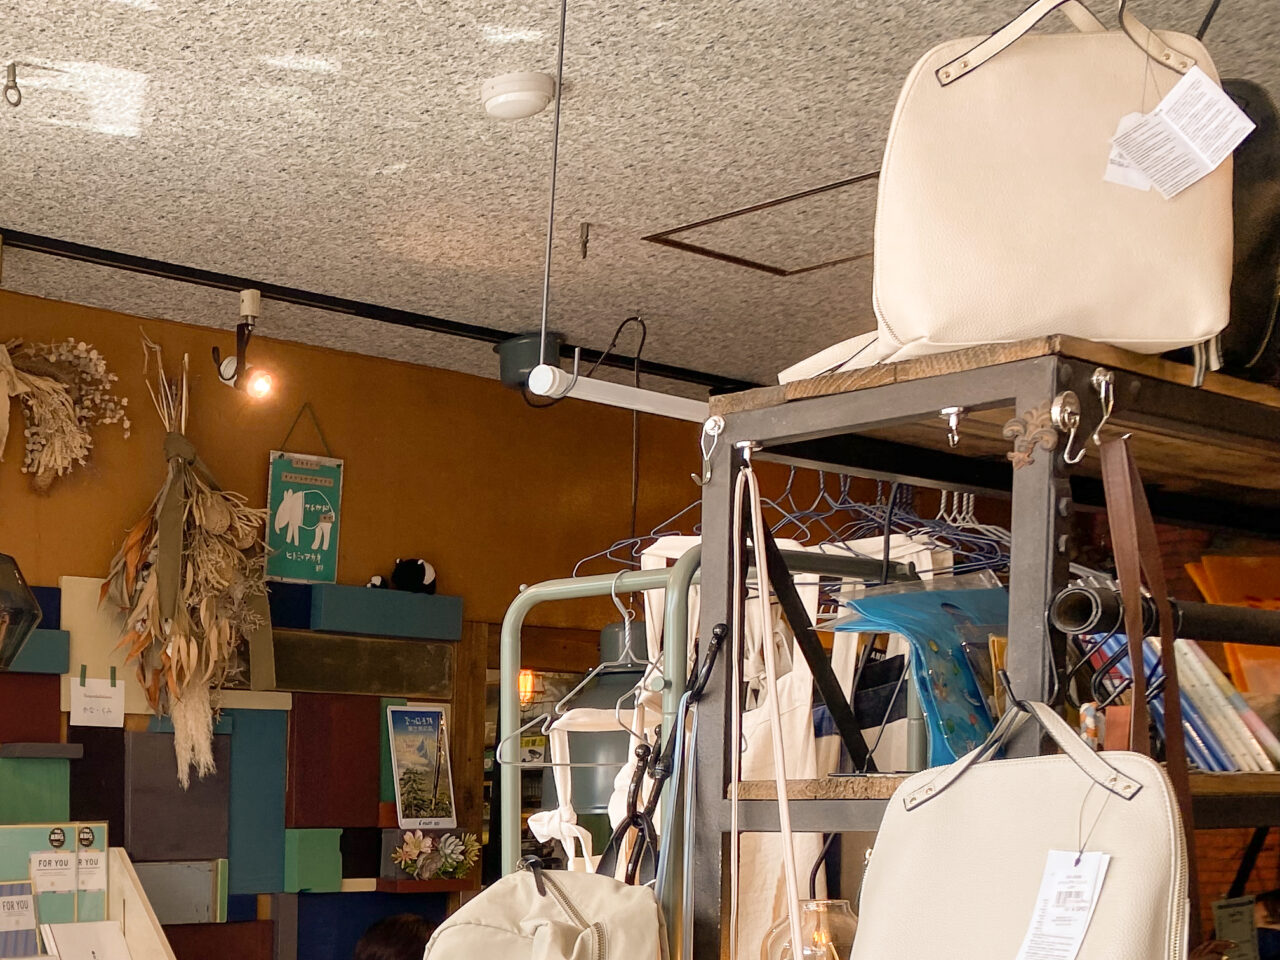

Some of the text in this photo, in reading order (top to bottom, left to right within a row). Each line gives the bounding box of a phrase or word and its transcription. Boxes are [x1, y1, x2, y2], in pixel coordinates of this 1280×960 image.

[38, 859, 52, 868] FOR
[54, 859, 69, 867] YOU
[85, 858, 99, 866] YOU
[2, 898, 29, 911] FOR YOU
